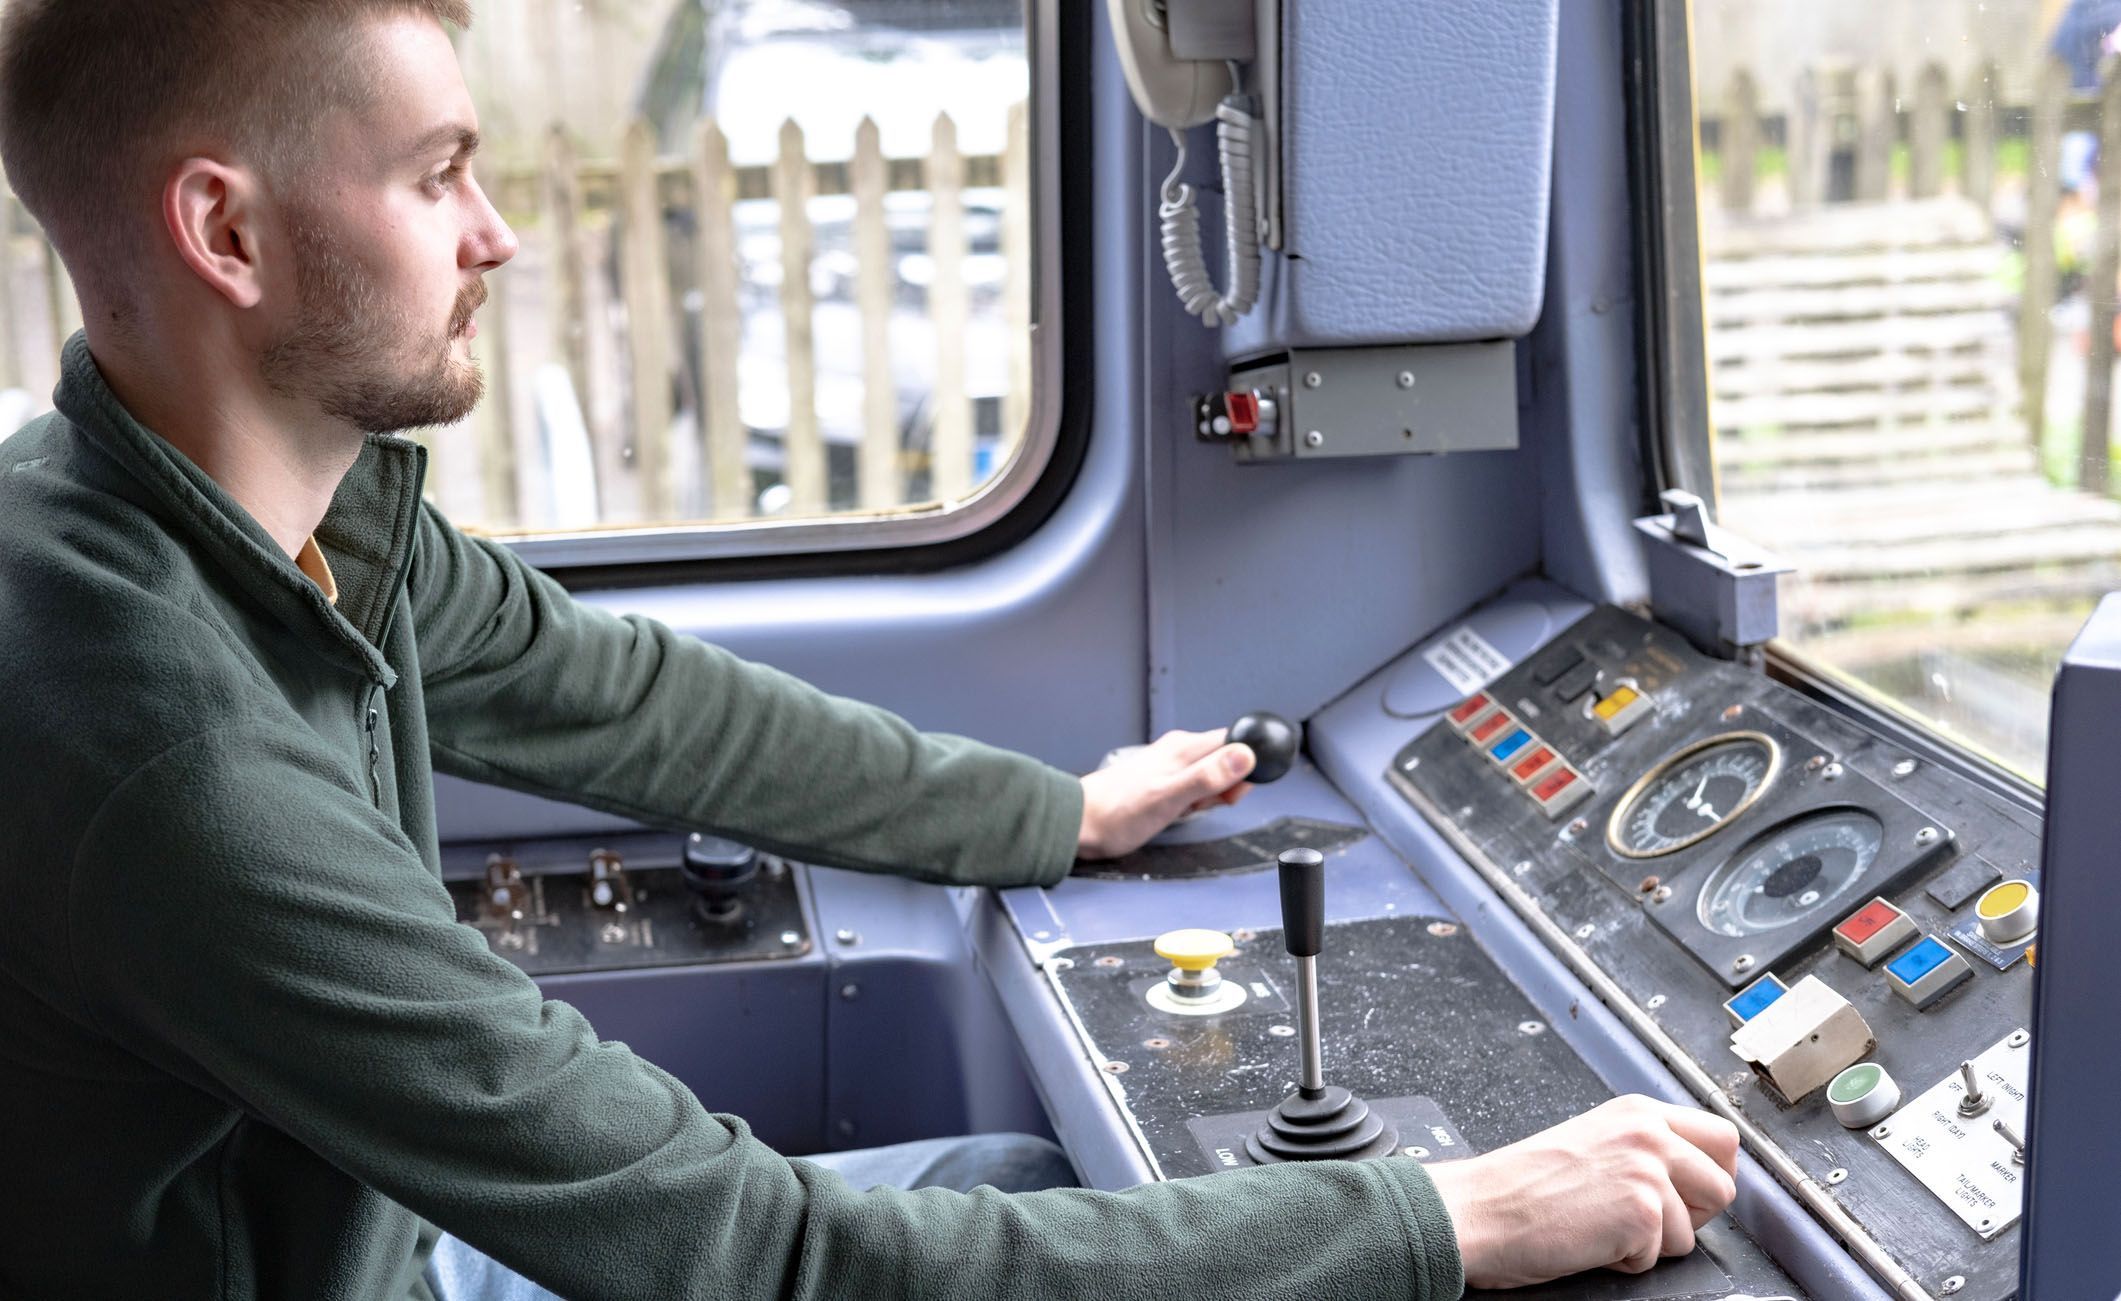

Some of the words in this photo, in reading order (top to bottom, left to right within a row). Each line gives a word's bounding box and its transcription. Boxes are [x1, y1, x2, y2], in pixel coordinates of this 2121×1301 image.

[1986, 1071, 2005, 1083] LEFT
[2003, 1083, 2025, 1101] (NIGHT)
[1934, 1110, 1951, 1126] RIGHT
[1949, 1122, 1966, 1139] (DAY)
[1430, 1125, 1455, 1147] HIGH
[1915, 1136, 1931, 1151] HEAD
[1215, 1147, 1239, 1166] LOW
[1990, 1161, 2017, 1184] MARKER
[1955, 1187, 1978, 1208] LIGHTS
[1956, 1173, 1996, 1209] TAIL/MARKER
